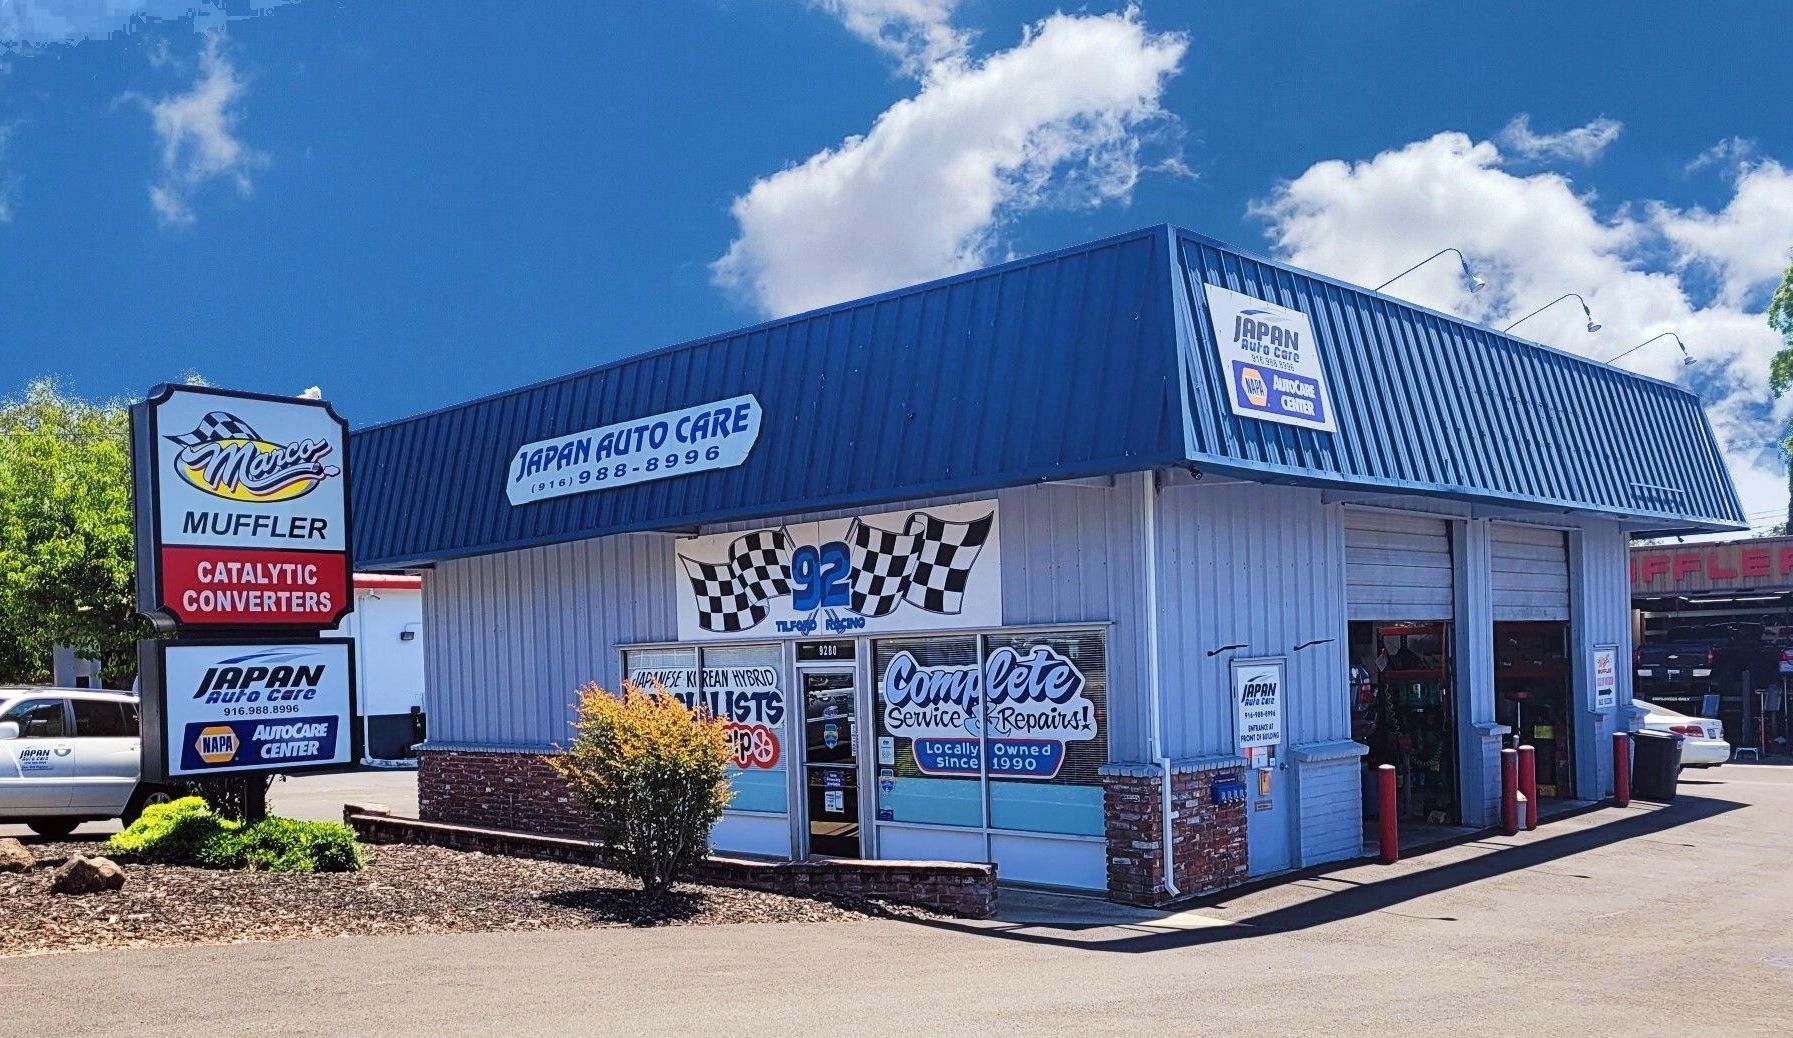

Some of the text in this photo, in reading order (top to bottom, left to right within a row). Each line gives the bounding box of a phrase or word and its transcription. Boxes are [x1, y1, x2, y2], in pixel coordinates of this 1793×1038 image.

[1233, 315, 1299, 351] JAPAN
[1241, 338, 1270, 356] Auto
[1245, 377, 1265, 396] NAPA
[1280, 395, 1316, 416] CENTER
[515, 402, 751, 483] JAPAN AUTO CARE
[180, 438, 333, 495] Marco
[531, 445, 720, 493] (916) 988-8996
[182, 511, 328, 540] MUFFLER
[197, 561, 318, 585] CATALYTIC
[792, 541, 851, 611] 92
[1630, 548, 1793, 583] FFLE
[182, 590, 332, 612] CONVERTERS
[775, 617, 866, 632] TILFORD RACING
[819, 645, 837, 656] 9280
[193, 665, 326, 699] JAPAN
[731, 668, 774, 688] HYBRID
[886, 650, 1082, 717] Complete
[205, 689, 261, 704] Auto
[1241, 682, 1277, 703] JAPAN
[224, 704, 299, 716] 916.988.8996
[888, 706, 962, 729] Service
[998, 706, 1092, 733] Repairs!
[202, 736, 233, 753] NAPA
[926, 741, 1051, 756] Locally Owned
[1241, 734, 1255, 742] FRONT
[19, 749, 50, 759] JAPAN
[260, 741, 319, 759] CENTER
[992, 757, 1037, 770] 1990
